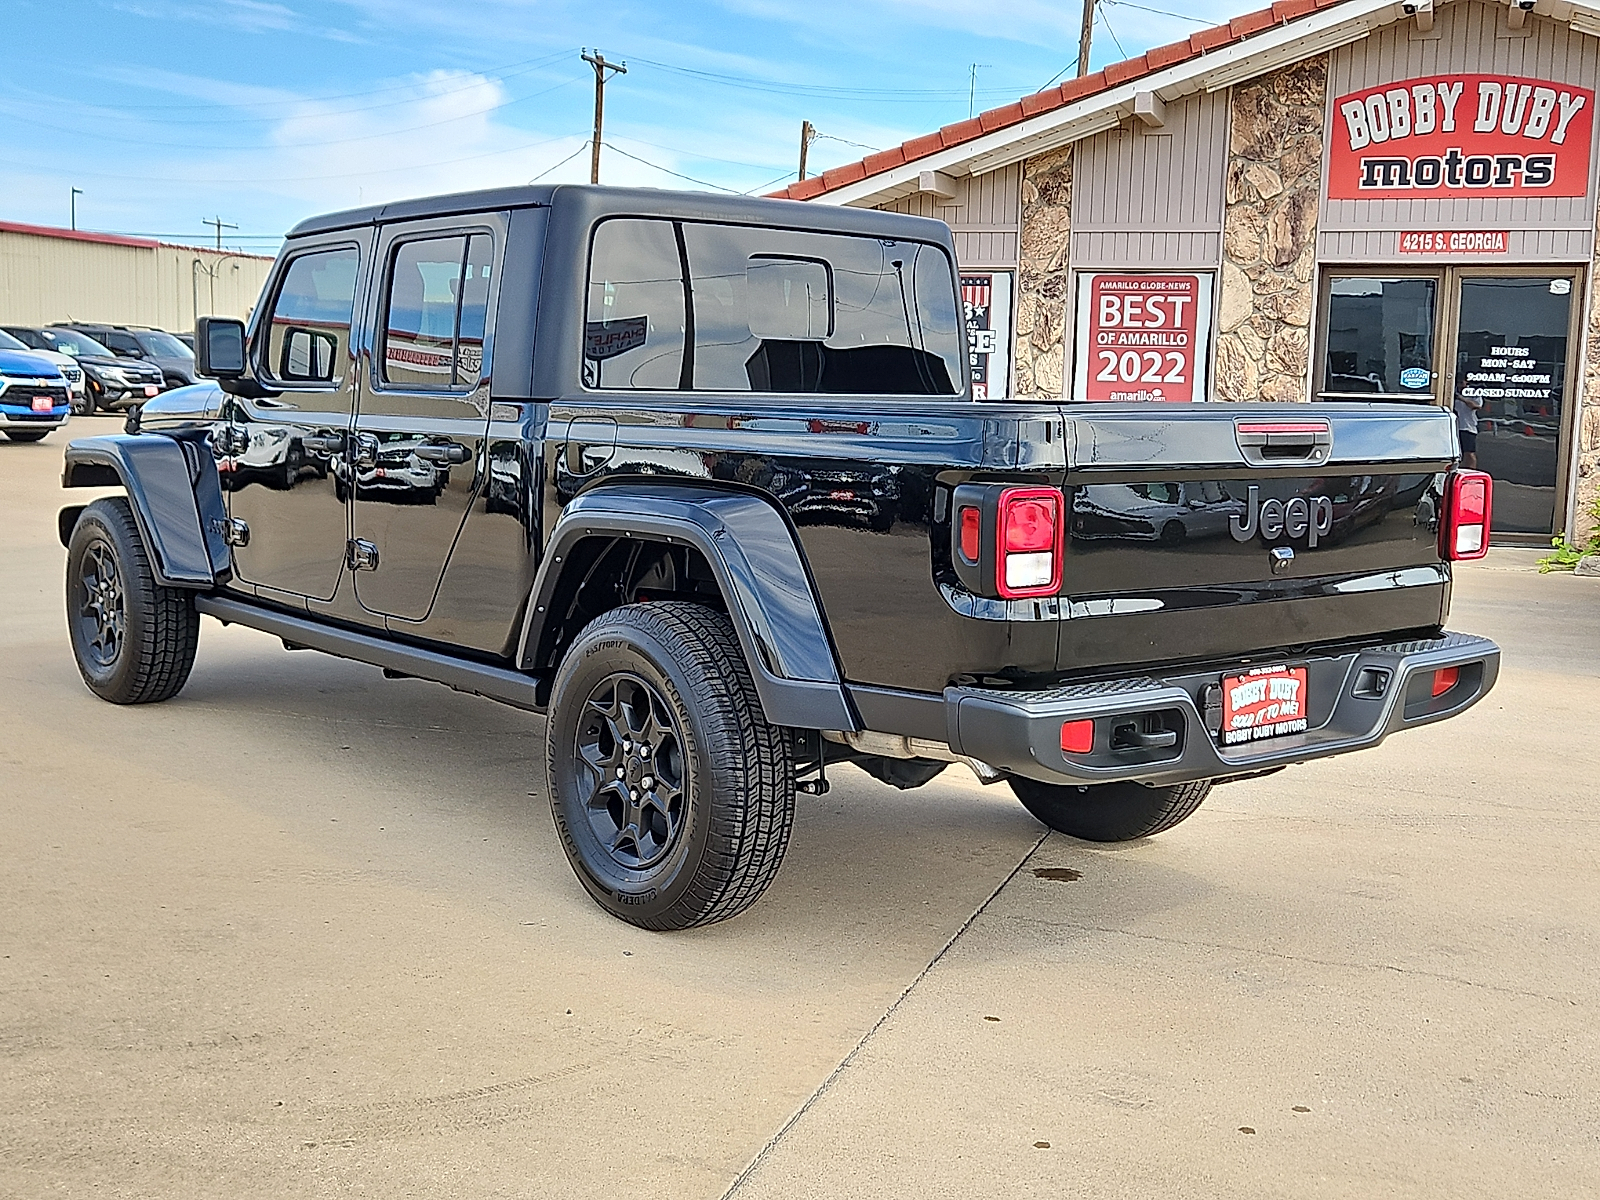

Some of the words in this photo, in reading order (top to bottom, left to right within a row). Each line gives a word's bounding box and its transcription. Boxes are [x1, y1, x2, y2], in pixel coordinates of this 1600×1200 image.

[1340, 81, 1464, 151] BOBBY
[1473, 81, 1586, 145] DUBY
[1359, 148, 1556, 190] motors
[1402, 233, 1432, 250] 4215
[1435, 233, 1447, 250] S.
[1450, 232, 1504, 250] GEORGIA
[1099, 281, 1139, 290] AMARILLO
[1140, 281, 1191, 290] GLOBE-NEWS
[1099, 295, 1192, 328] BEST
[1097, 332, 1116, 345] OF
[1118, 332, 1188, 346] AMARILLO
[1480, 358, 1536, 369] MON-SAT
[1490, 346, 1529, 357] HOURS
[1096, 350, 1186, 383] 2022
[1461, 387, 1504, 397] CLOSED
[1505, 388, 1551, 398] SUNDAY
[1228, 485, 1333, 547] Jeep
[1230, 679, 1267, 712] BOBBY
[1269, 677, 1300, 701] DUBY
[1255, 708, 1267, 725] IT
[1266, 703, 1280, 720] TO
[1226, 727, 1252, 744] BOBBY
[1253, 724, 1274, 739] DUBY
[1275, 718, 1307, 735] MOTORS
